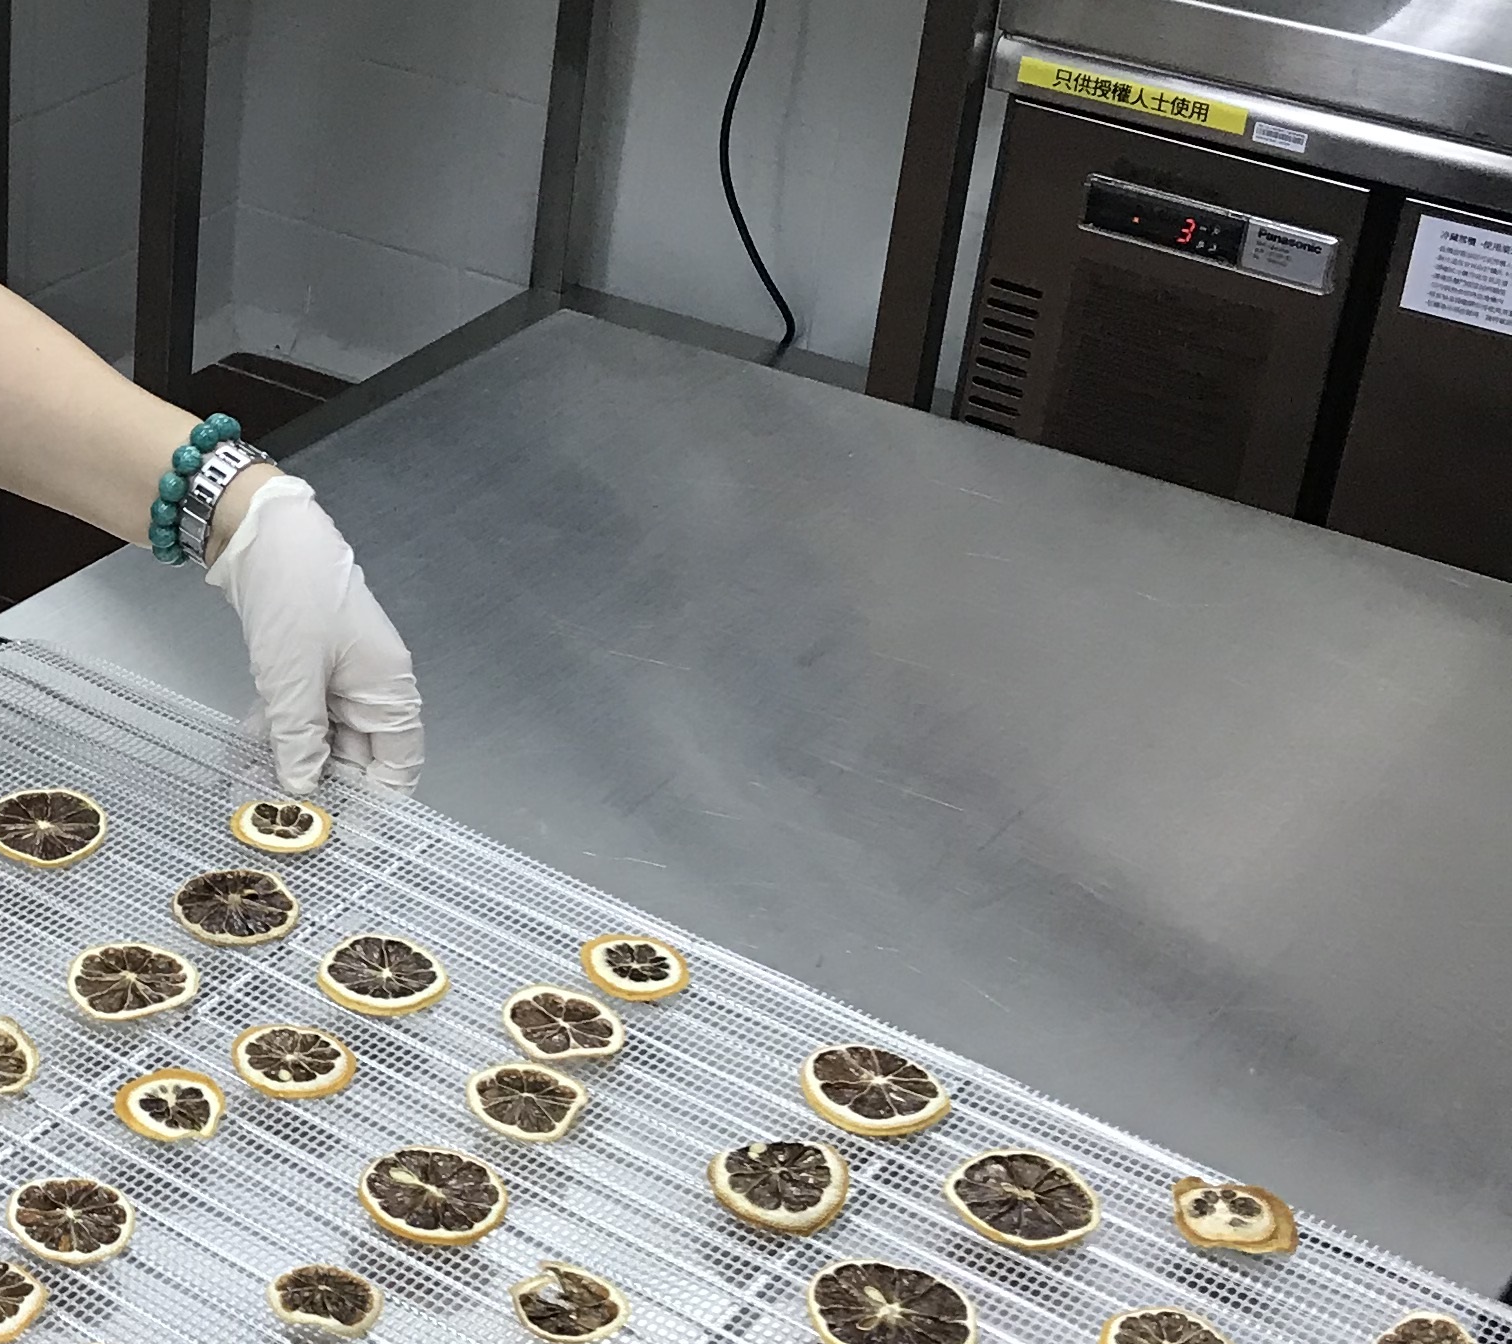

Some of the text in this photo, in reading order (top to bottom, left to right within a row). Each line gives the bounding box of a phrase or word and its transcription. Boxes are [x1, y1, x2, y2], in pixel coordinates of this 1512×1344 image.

[1053, 69, 1210, 122] 只供授權人士使用
[1176, 218, 1196, 244] 3
[1258, 228, 1322, 255] Panasonic
